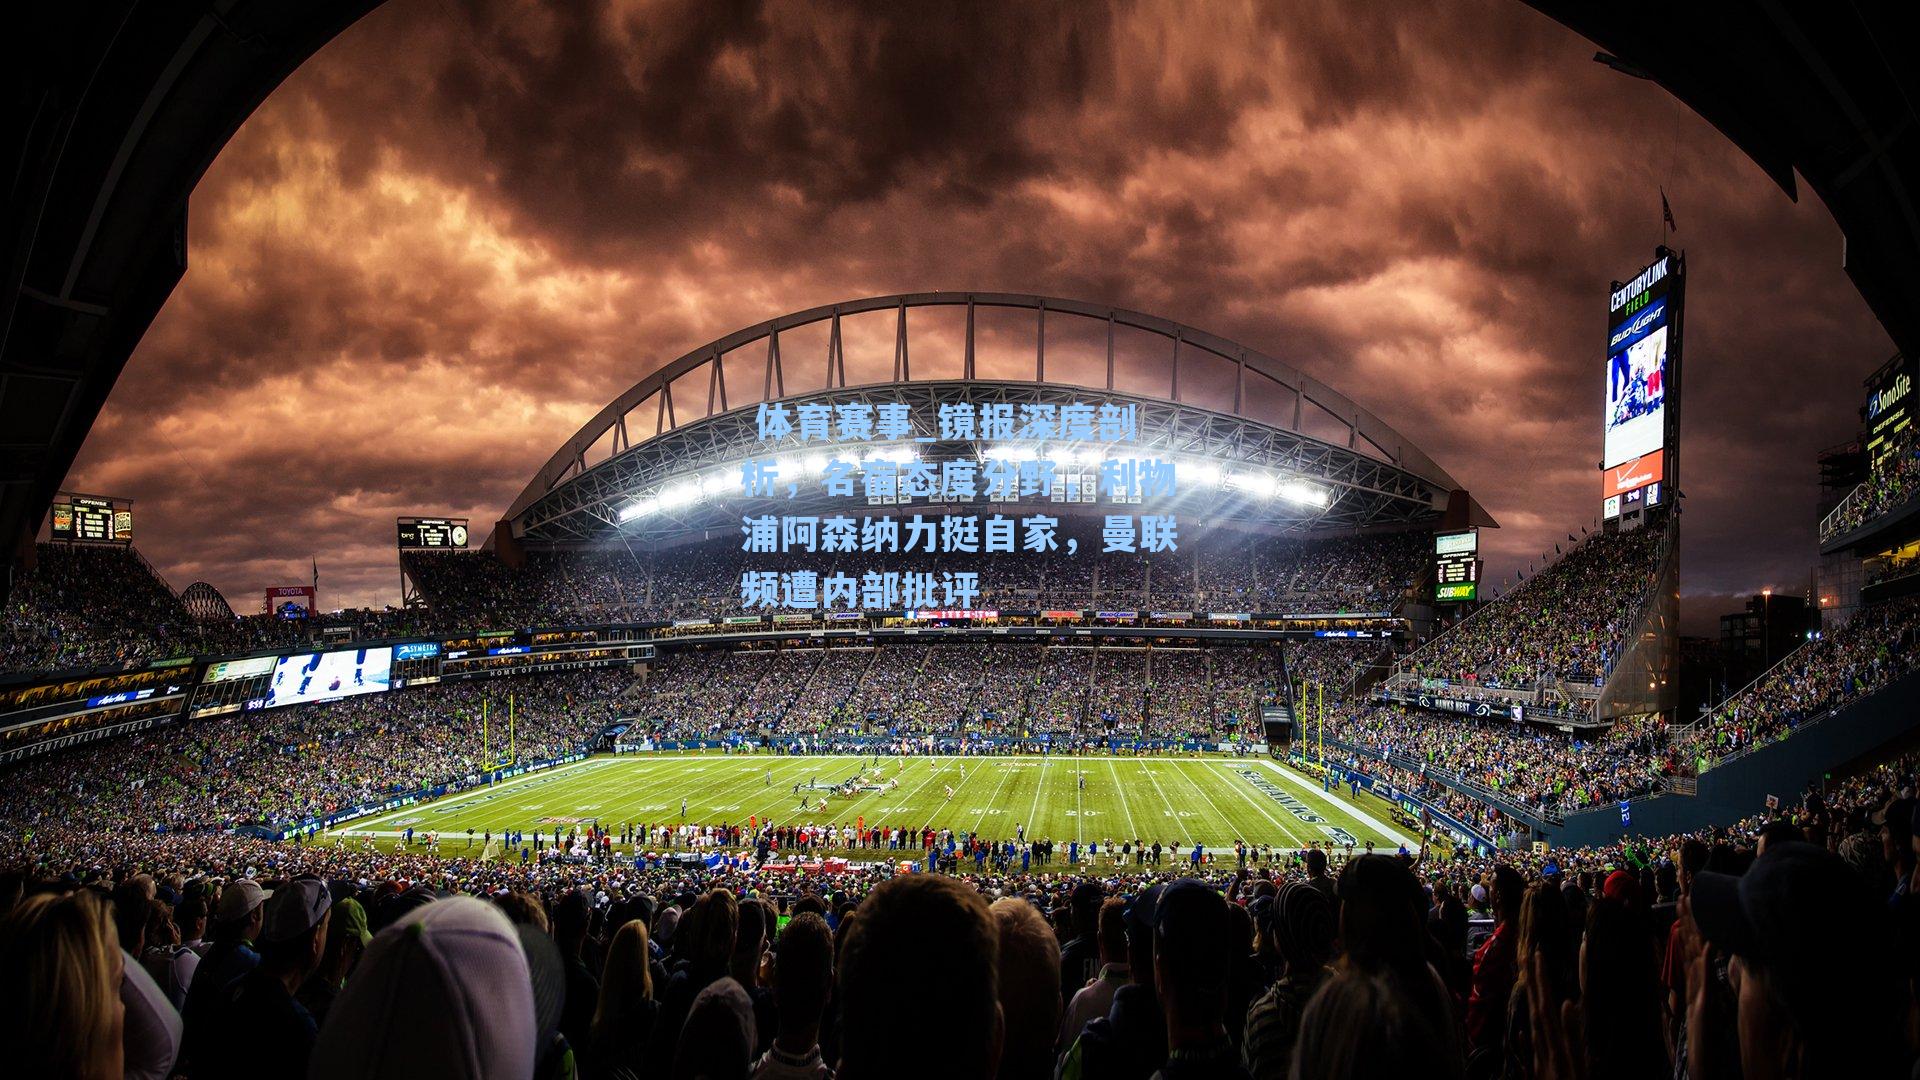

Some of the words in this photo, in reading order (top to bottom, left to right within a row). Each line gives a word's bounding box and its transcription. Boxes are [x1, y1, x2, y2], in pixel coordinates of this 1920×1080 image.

[1610, 256, 1668, 312] CENTURYLINK
[1625, 290, 1649, 316] FIELD
[1610, 327, 1632, 346] BUD
[1632, 306, 1665, 333] LIGHT
[1877, 373, 1911, 414] SonoSite
[80, 499, 107, 507] OFFENSE
[401, 532, 415, 540] bing
[279, 587, 304, 596] TOYOTA
[1437, 585, 1474, 598] SUBWAY
[410, 644, 437, 652] SYMETRA
[490, 669, 516, 677] HOME
[538, 664, 555, 672] THE
[589, 660, 609, 668] MAN
[9, 749, 24, 762] TO
[30, 728, 112, 756] CENTURYLINK
[118, 719, 153, 735] FIELD
